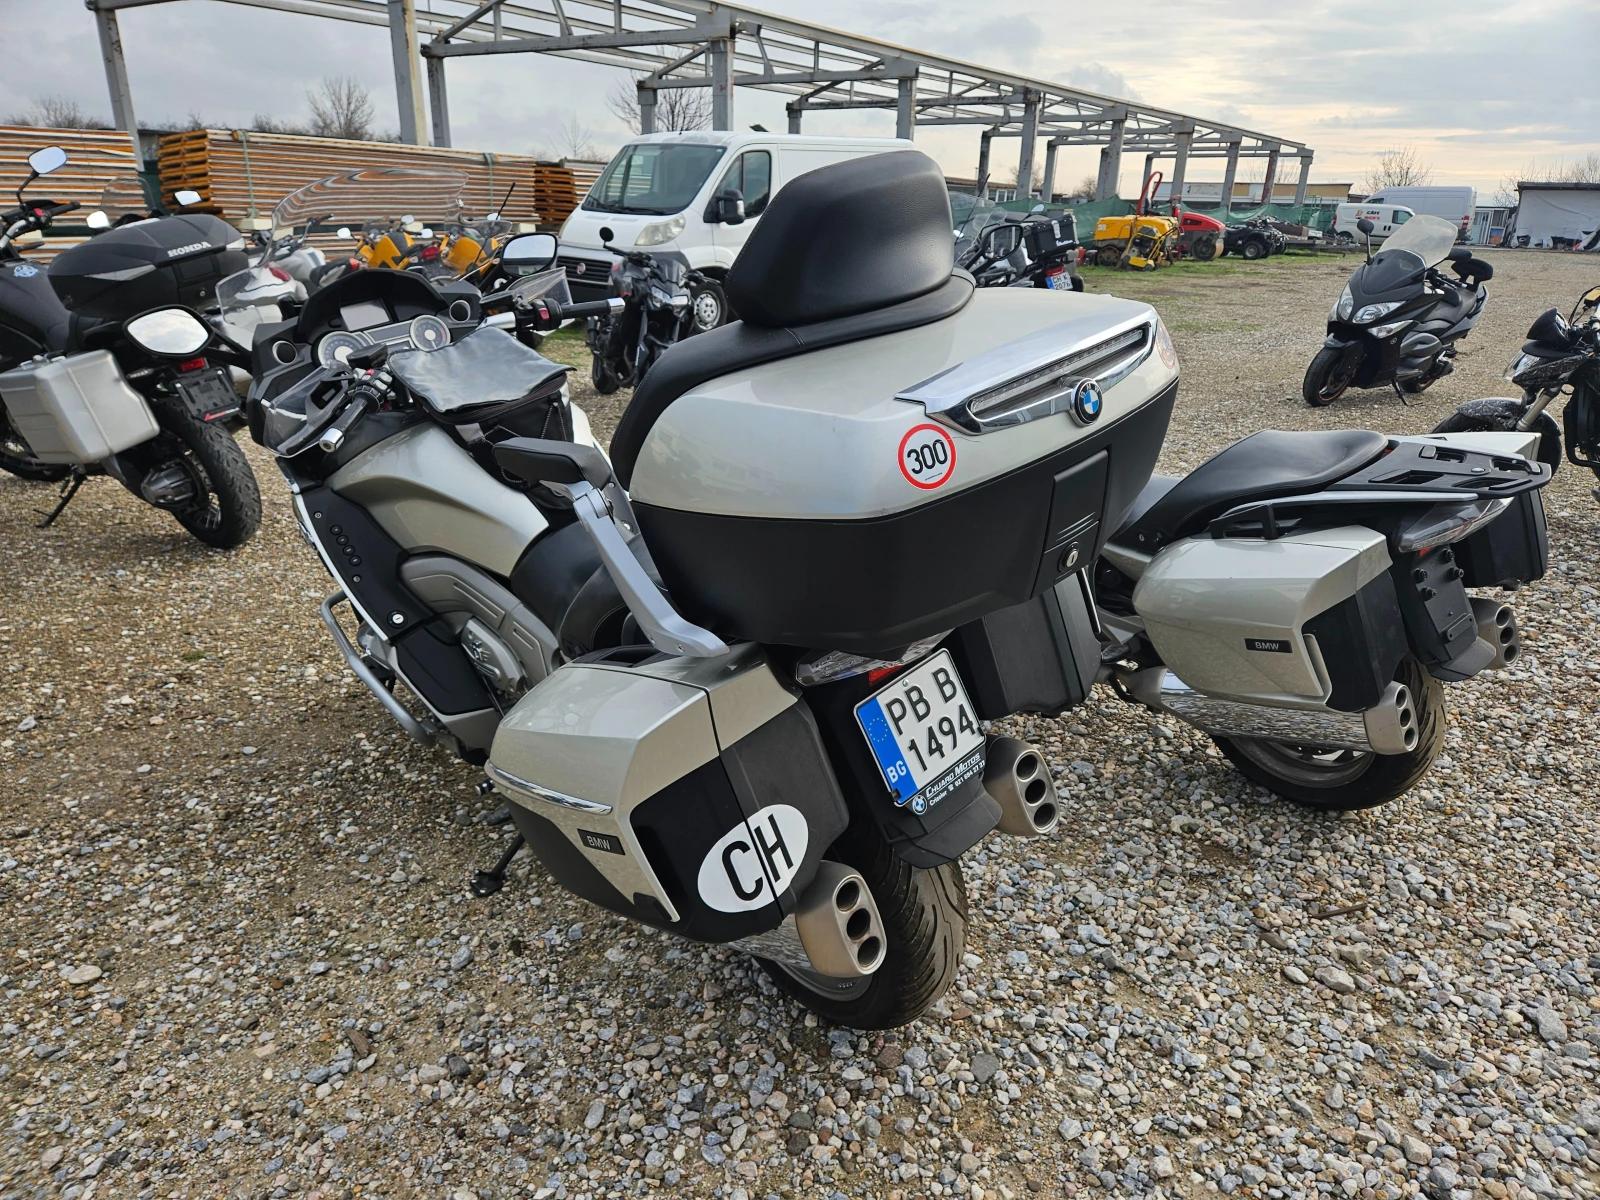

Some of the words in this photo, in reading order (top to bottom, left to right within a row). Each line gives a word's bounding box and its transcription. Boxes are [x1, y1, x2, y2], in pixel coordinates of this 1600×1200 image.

[167, 241, 212, 258] HONDA
[1052, 275, 1061, 284] CH
[1055, 281, 1071, 290] 2076
[907, 439, 948, 474] 300
[1254, 641, 1279, 650] BMW
[886, 685, 931, 735] PB
[932, 667, 957, 703] B
[909, 703, 976, 772] 1494
[886, 760, 907, 783] BG
[586, 835, 611, 850] BMW
[722, 813, 794, 902] CH
